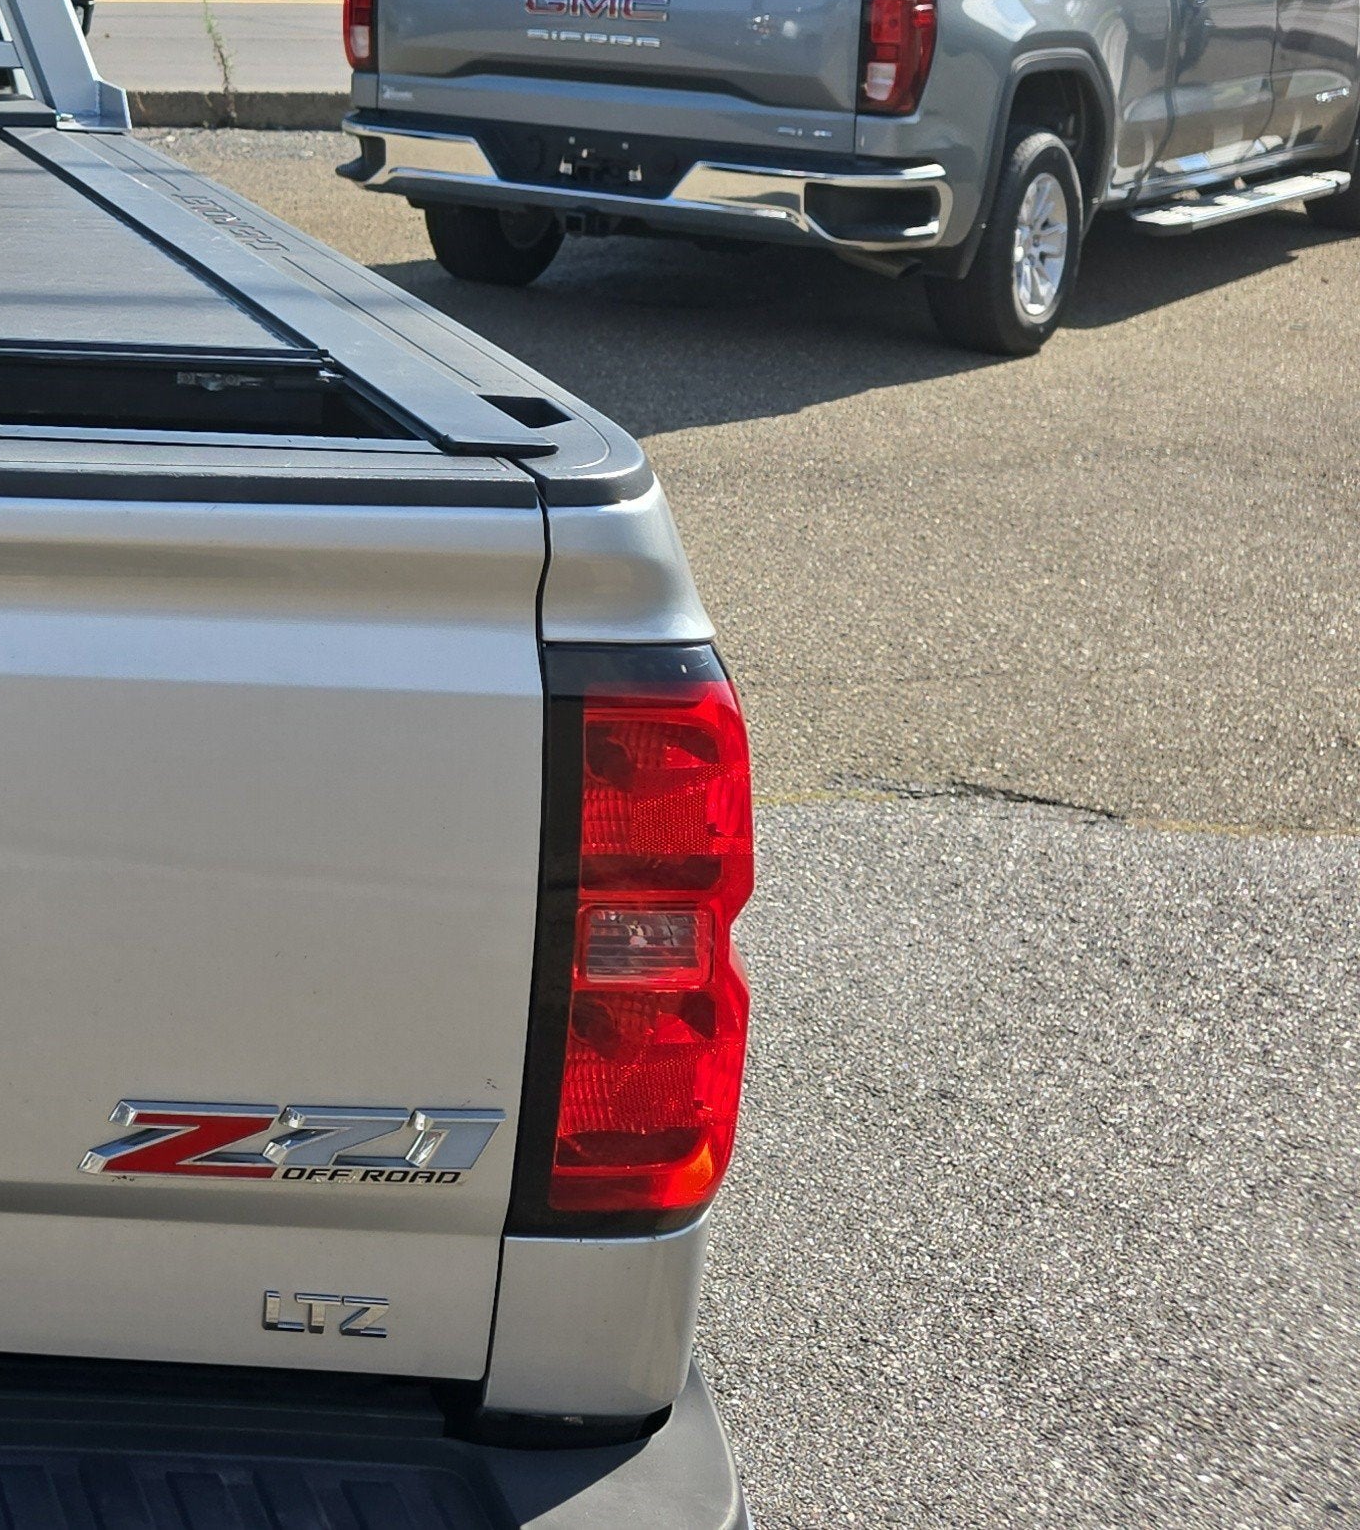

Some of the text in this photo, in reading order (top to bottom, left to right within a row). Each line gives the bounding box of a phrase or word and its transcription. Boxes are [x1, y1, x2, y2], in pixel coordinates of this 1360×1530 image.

[79, 1100, 507, 1180] Z71
[282, 1168, 462, 1185] OFF ROAD
[262, 1290, 390, 1338] LTZ
